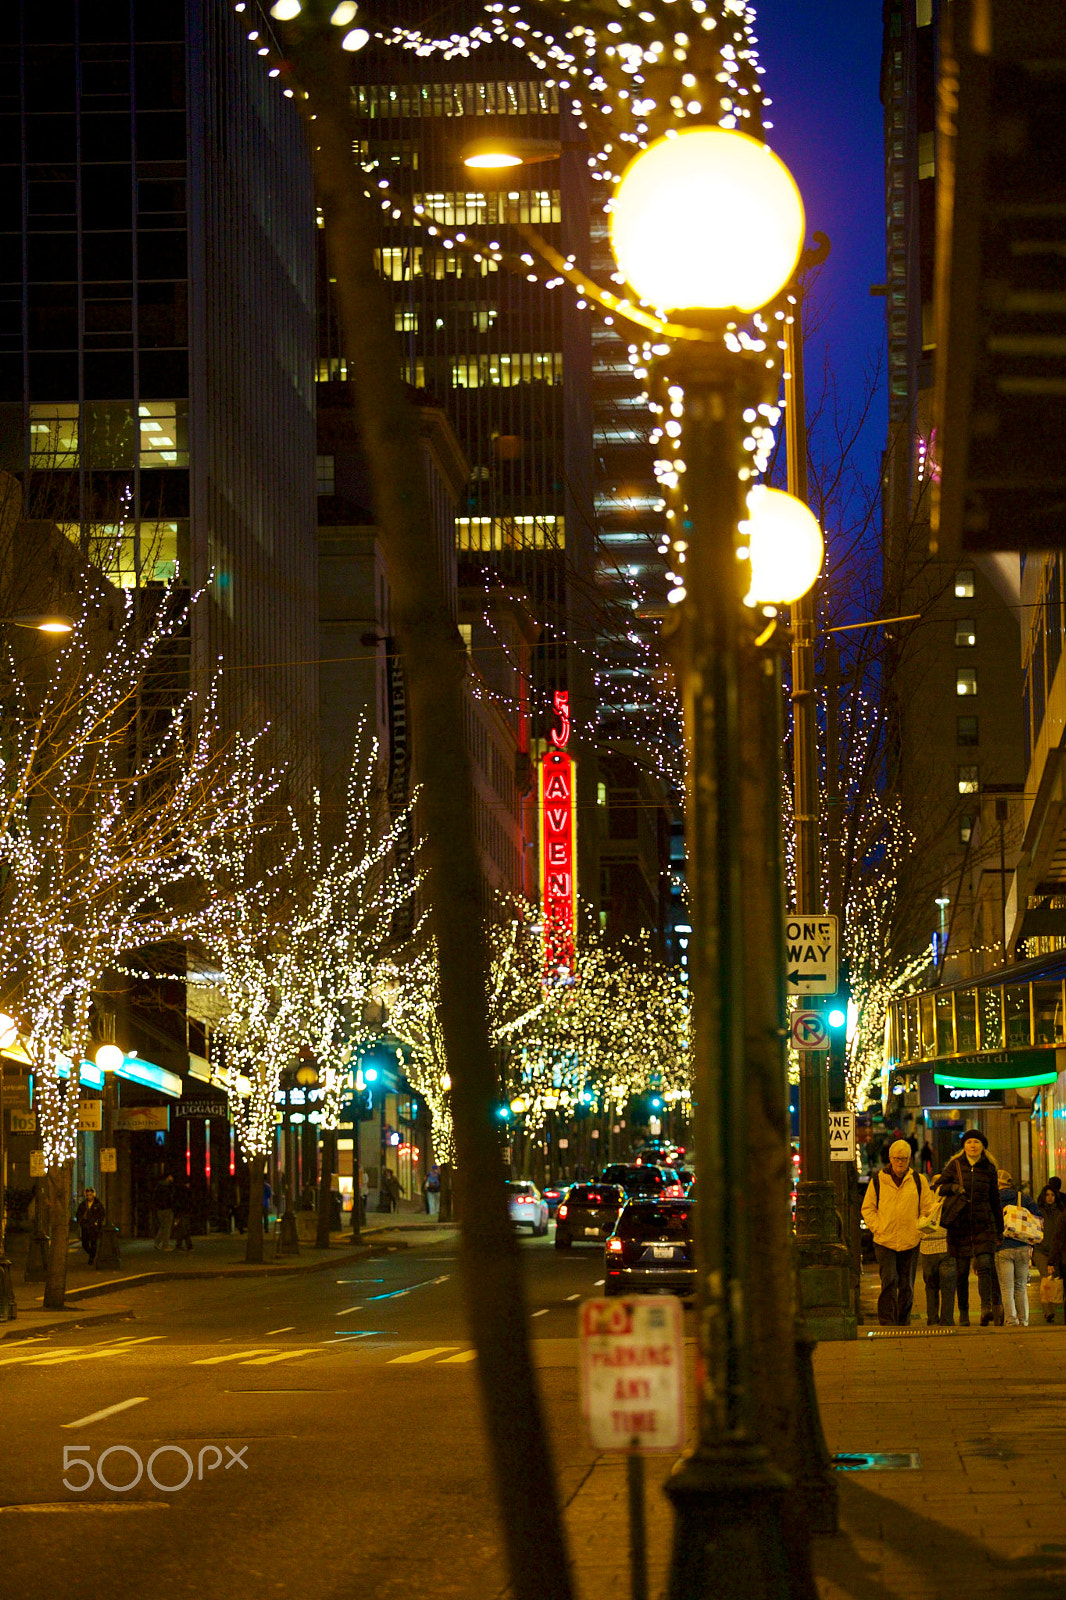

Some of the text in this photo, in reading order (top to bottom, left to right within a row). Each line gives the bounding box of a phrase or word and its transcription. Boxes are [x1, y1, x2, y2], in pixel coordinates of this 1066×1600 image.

[551, 690, 570, 747] 5
[787, 923, 830, 941] ONE
[787, 945, 832, 962] WAY
[175, 1105, 226, 1117] LUGGAGE
